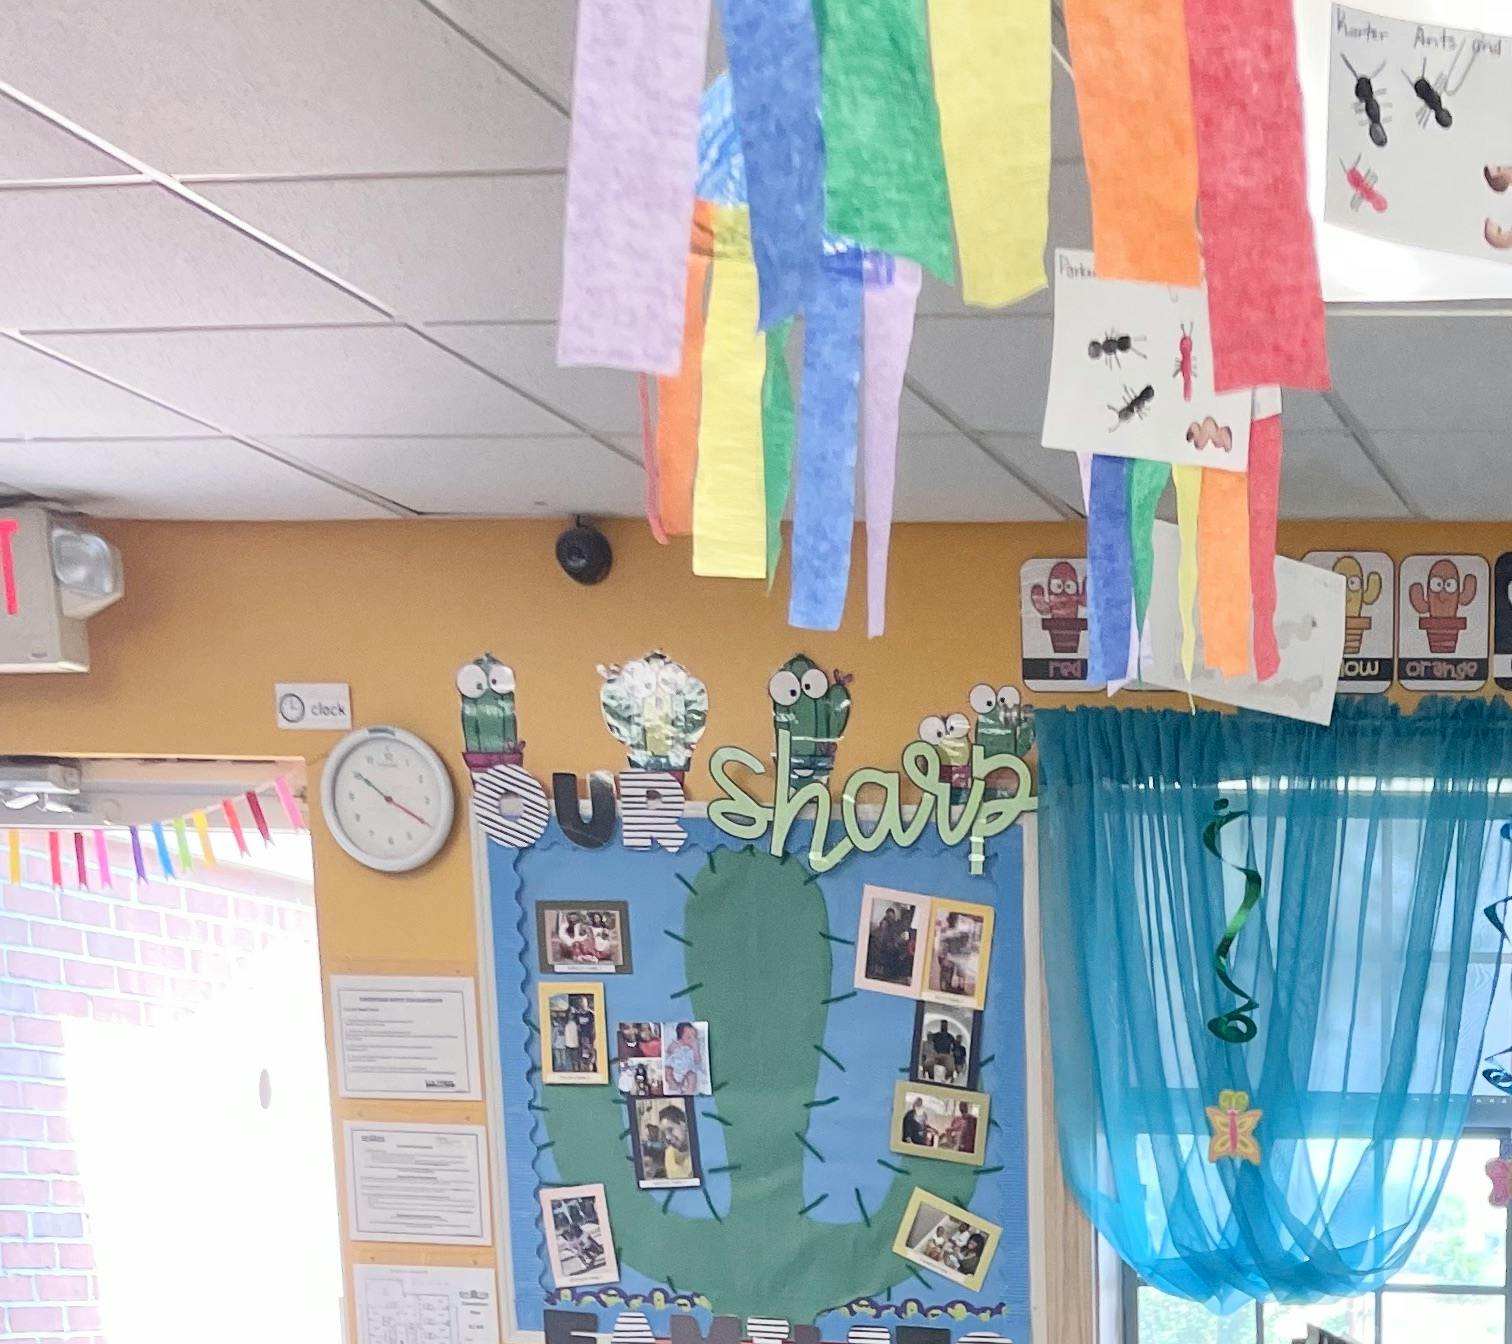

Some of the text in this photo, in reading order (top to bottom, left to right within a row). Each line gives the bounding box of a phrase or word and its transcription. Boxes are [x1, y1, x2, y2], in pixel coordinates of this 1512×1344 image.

[1414, 26, 1457, 50] Ants
[1050, 658, 1080, 679] red
[1405, 659, 1479, 681] orange
[311, 701, 346, 717] clock
[474, 764, 689, 853] OUR
[707, 728, 1038, 877] sharp
